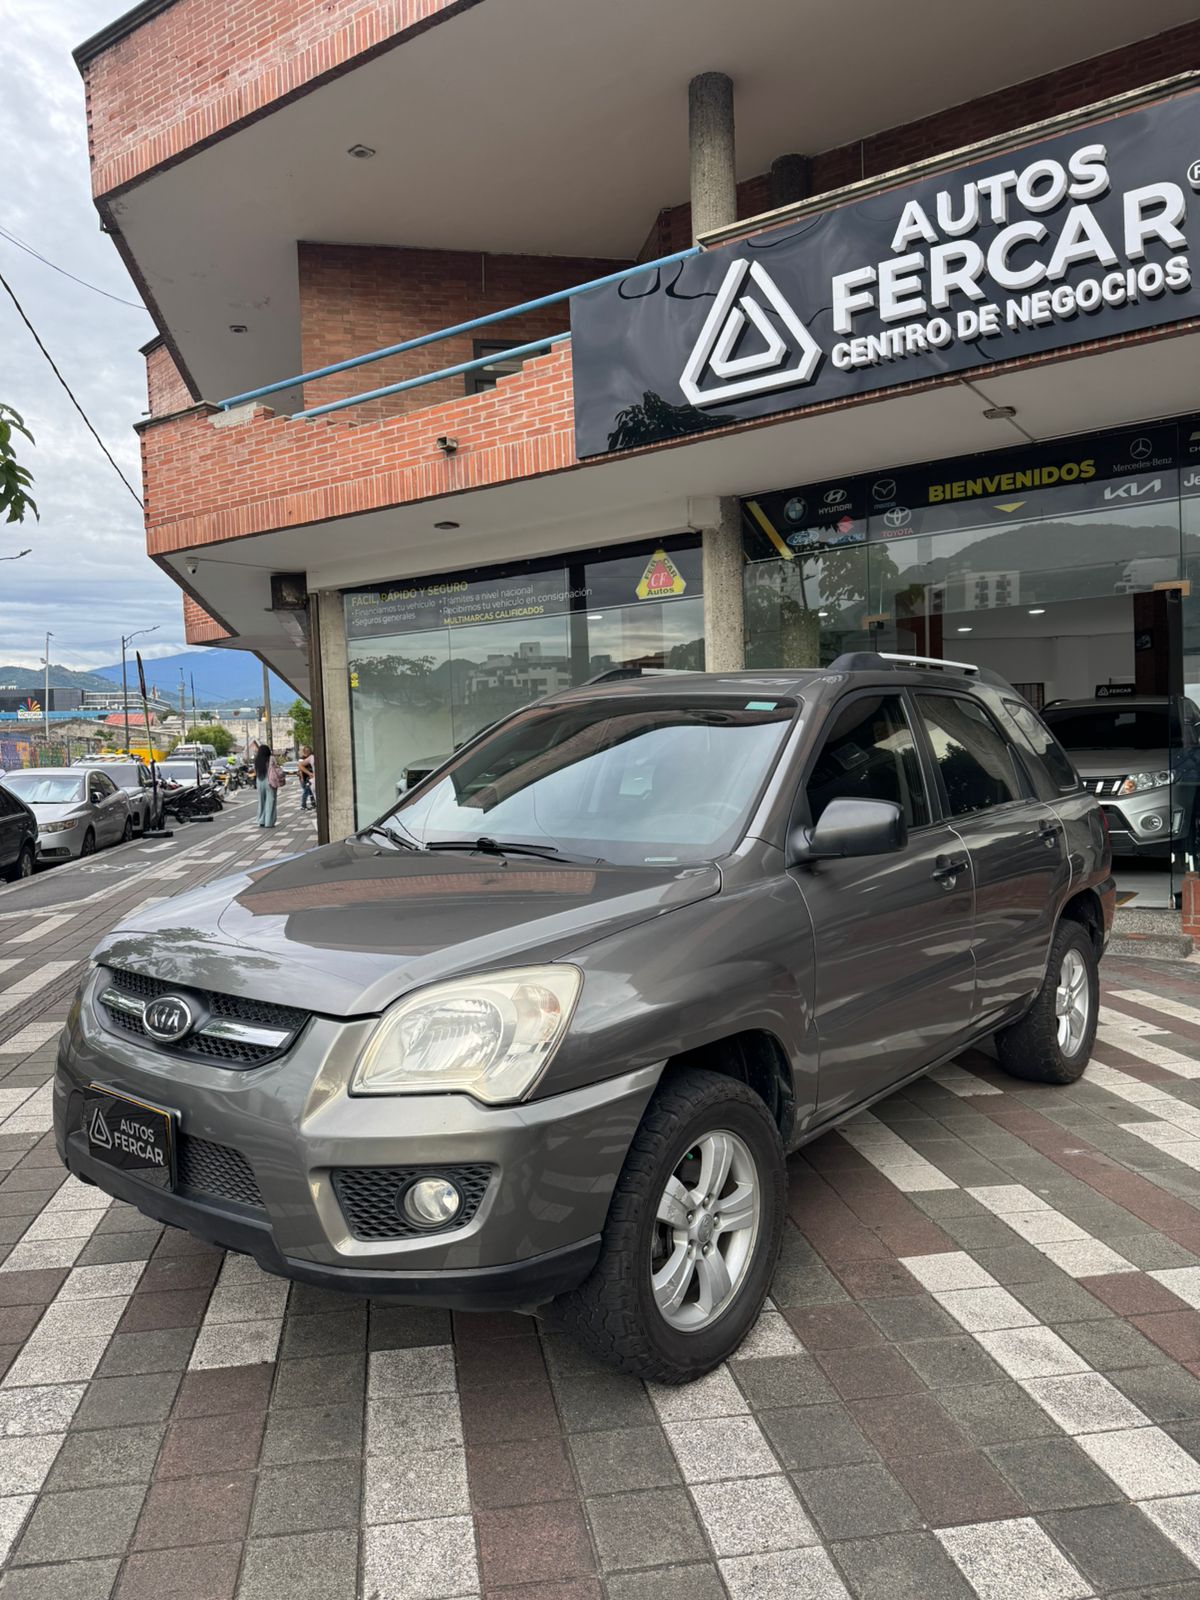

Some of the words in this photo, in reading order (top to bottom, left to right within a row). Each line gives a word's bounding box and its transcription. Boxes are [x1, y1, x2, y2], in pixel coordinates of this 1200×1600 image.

[891, 144, 1109, 253] AUTOS
[832, 182, 1189, 335] FERCAR
[831, 318, 951, 371] CENTRO
[957, 304, 1001, 342] DE
[1006, 256, 1192, 329] NEGOCIOS
[1112, 457, 1172, 473] Mercedes-Benz
[928, 459, 1097, 503] BIENVENIDOS
[819, 503, 852, 515] HYUNDAI
[881, 528, 914, 538] TOYOTA
[420, 588, 425, 597] Y
[428, 581, 468, 596] SEGURO
[481, 589, 499, 600] nivel
[501, 585, 534, 597] nacional
[397, 603, 405, 611] tu
[443, 600, 481, 615] Recibimos
[482, 601, 491, 610] tu
[526, 596, 536, 604] en
[538, 587, 593, 602] consignación
[356, 617, 381, 628] Seguros
[382, 612, 416, 625] generales
[443, 611, 493, 625] MULTIMARCAS
[495, 605, 544, 619] CALIFICADOS
[150, 1005, 180, 1032] KIA
[120, 1119, 154, 1143] AUTOS
[114, 1133, 165, 1166] FERCAR
